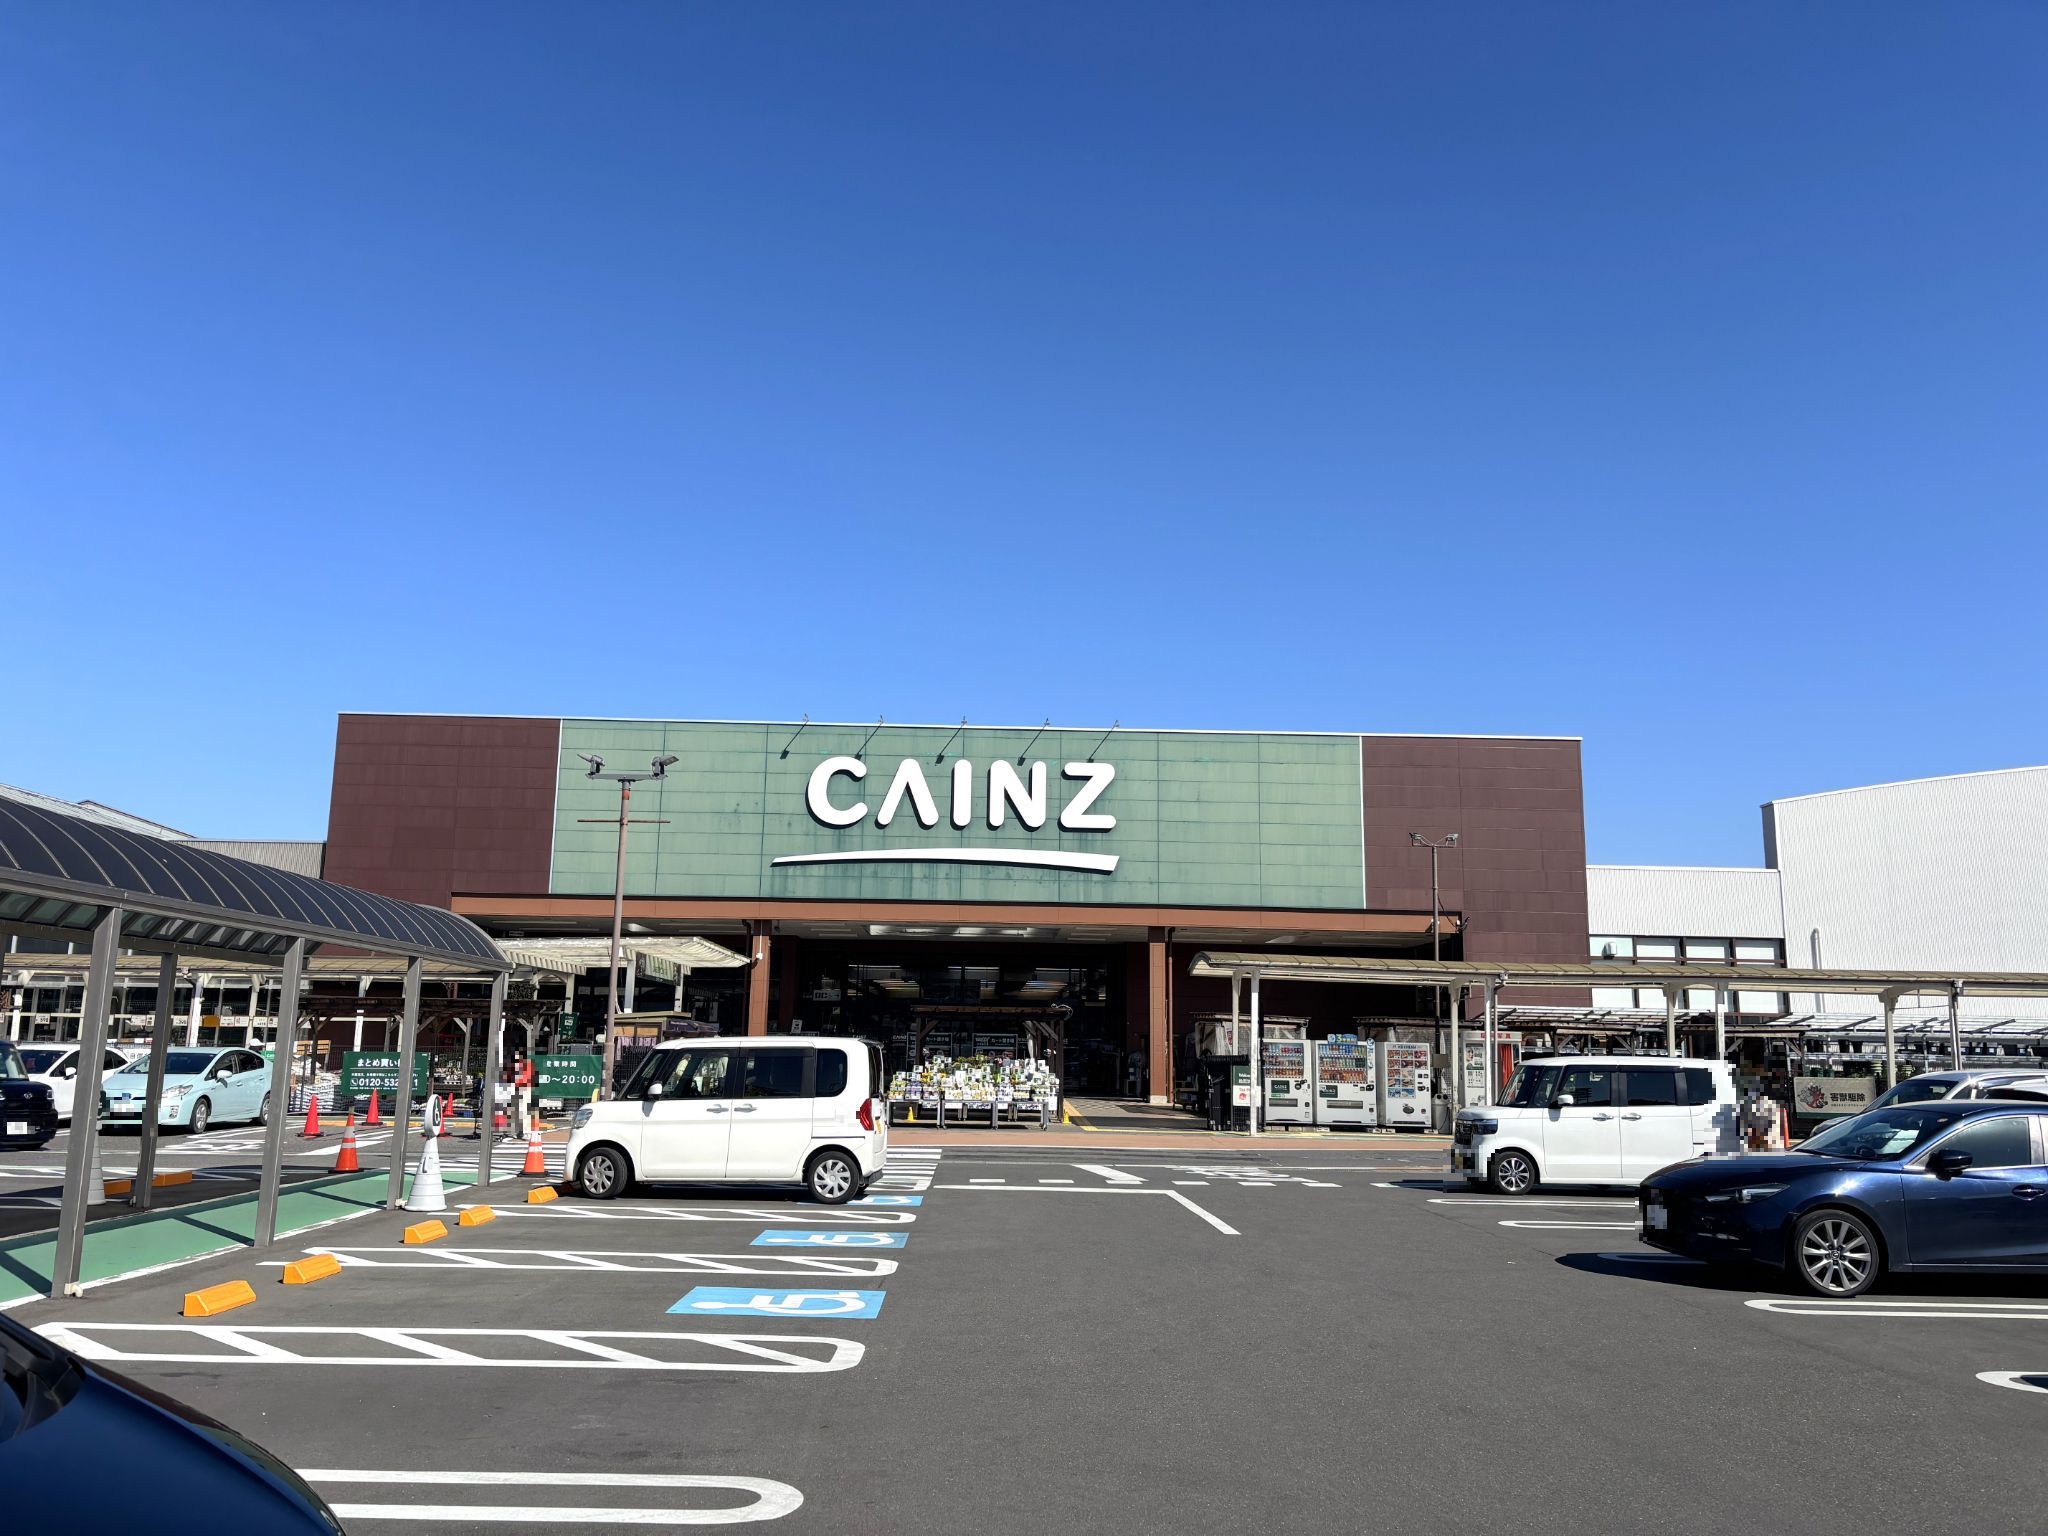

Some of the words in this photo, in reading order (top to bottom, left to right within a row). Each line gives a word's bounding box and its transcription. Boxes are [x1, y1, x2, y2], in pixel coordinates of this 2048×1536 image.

[805, 756, 1117, 832] CAINZ
[1830, 1092, 1866, 1102] 害獣駆除
